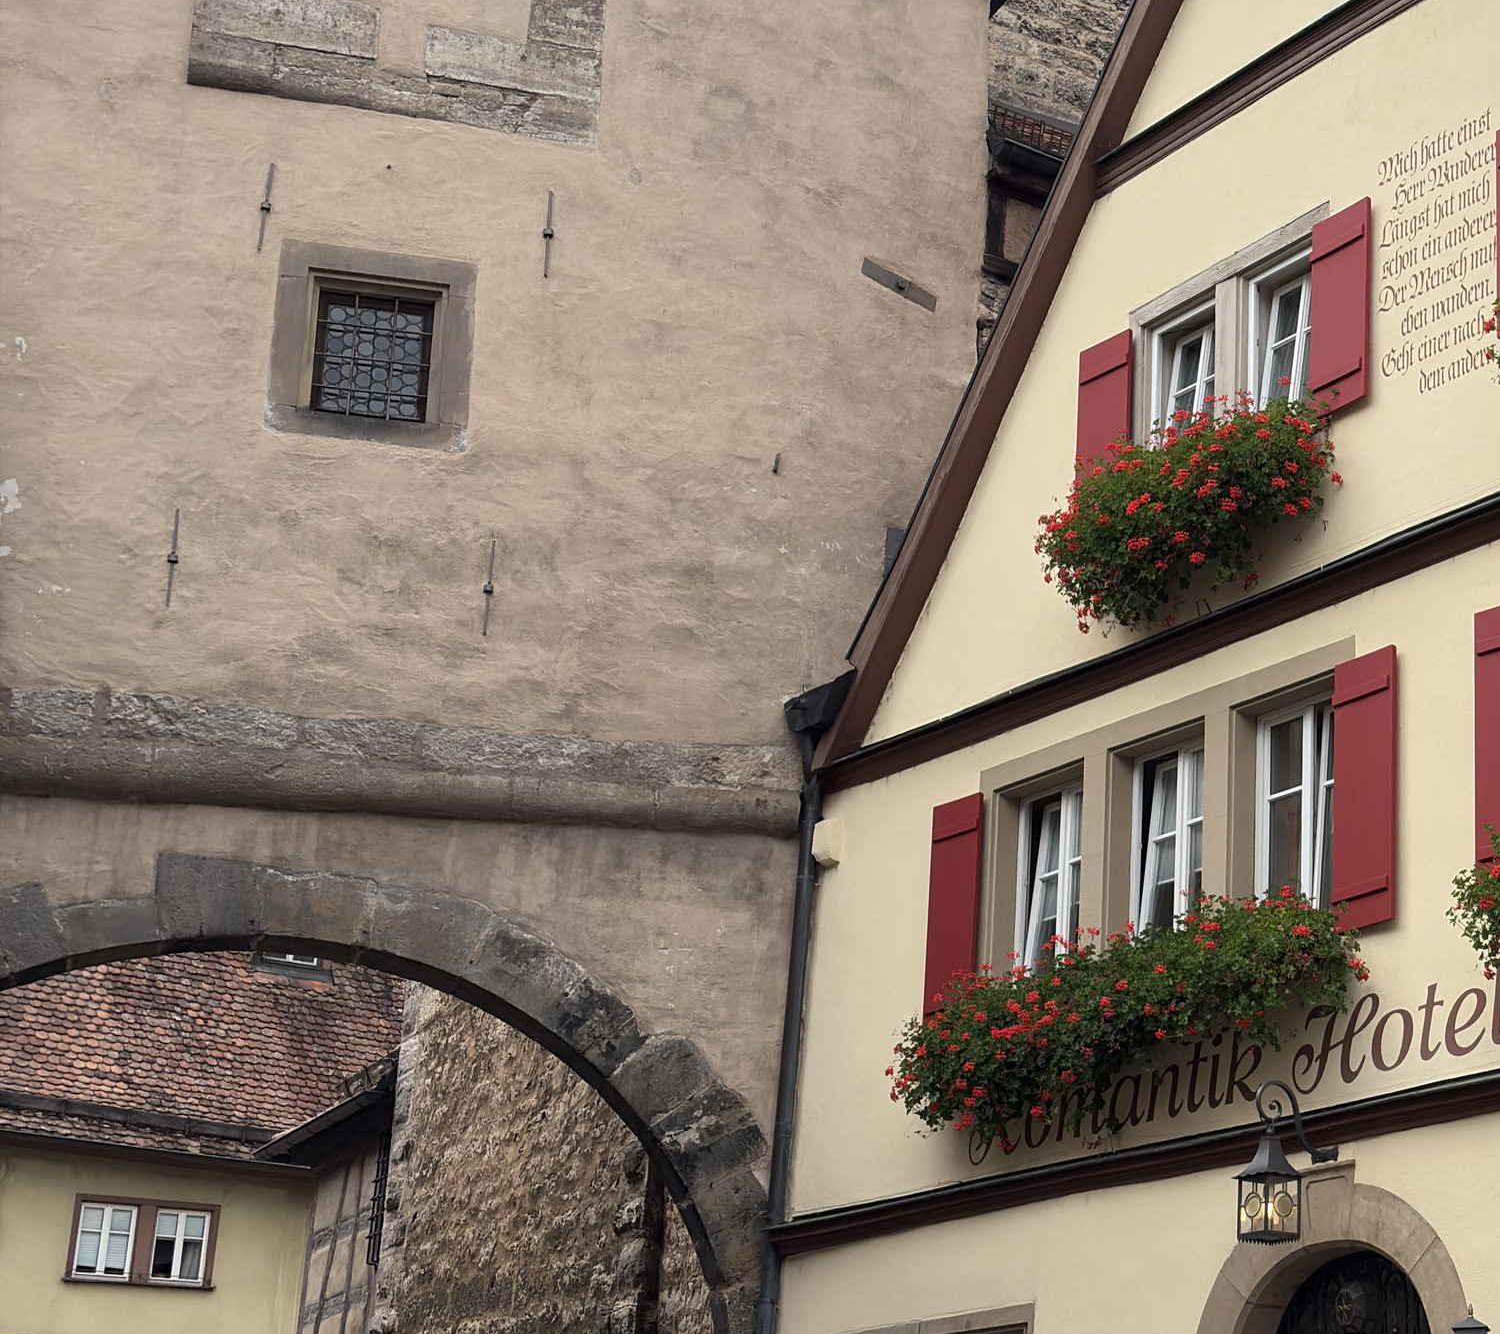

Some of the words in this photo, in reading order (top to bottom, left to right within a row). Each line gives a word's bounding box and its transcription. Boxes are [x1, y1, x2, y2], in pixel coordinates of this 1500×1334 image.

[1378, 141, 1417, 186] Mich
[1421, 129, 1454, 171] hatte
[1457, 106, 1491, 146] einst
[1378, 205, 1431, 250] Längst
[1434, 191, 1455, 229] hat
[1458, 170, 1490, 211] mich
[1391, 178, 1426, 214] Herr
[1377, 285, 1407, 314] Der
[1409, 247, 1467, 300] Mensch
[1381, 245, 1418, 281] schon
[1422, 234, 1441, 261] ein
[1401, 306, 1428, 337] eben
[1432, 278, 1494, 323] wandern.
[1382, 341, 1415, 377] Geht
[1418, 331, 1450, 362] einer
[1419, 367, 1445, 394] dem
